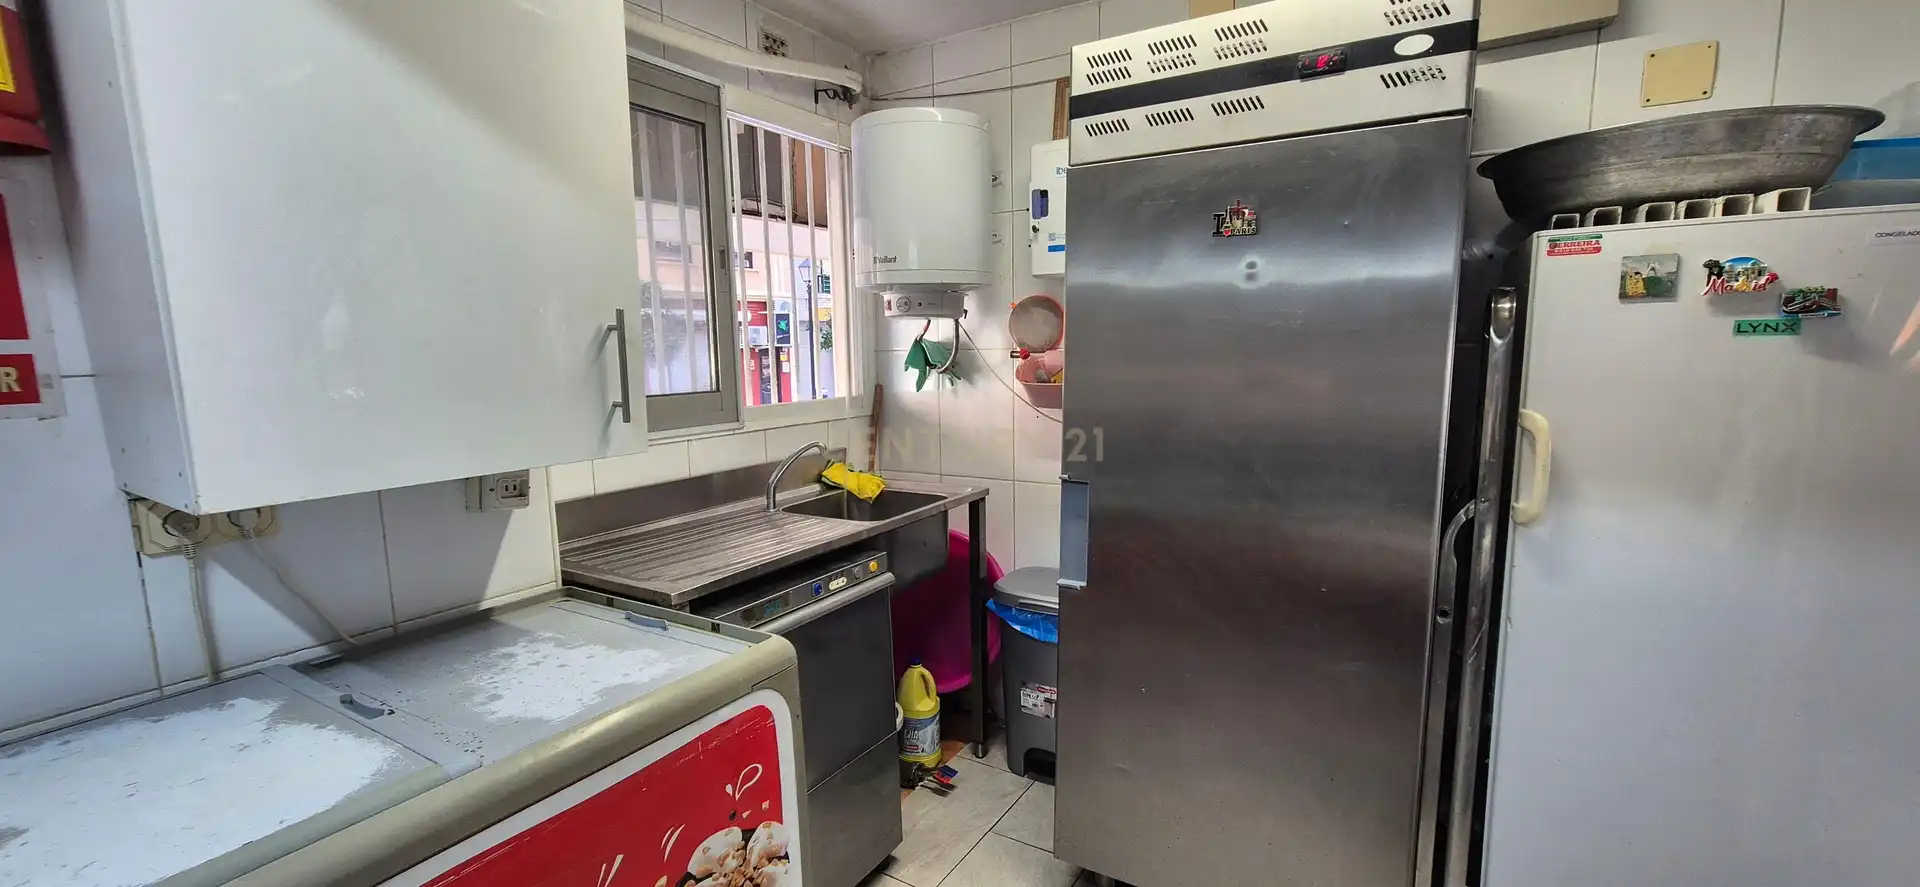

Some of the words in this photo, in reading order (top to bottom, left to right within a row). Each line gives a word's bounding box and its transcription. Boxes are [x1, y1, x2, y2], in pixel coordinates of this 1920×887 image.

[1231, 227, 1256, 235] PARIS
[1700, 275, 1771, 296] Madrid
[1736, 321, 1797, 334] LYNX
[0, 366, 23, 393] R
